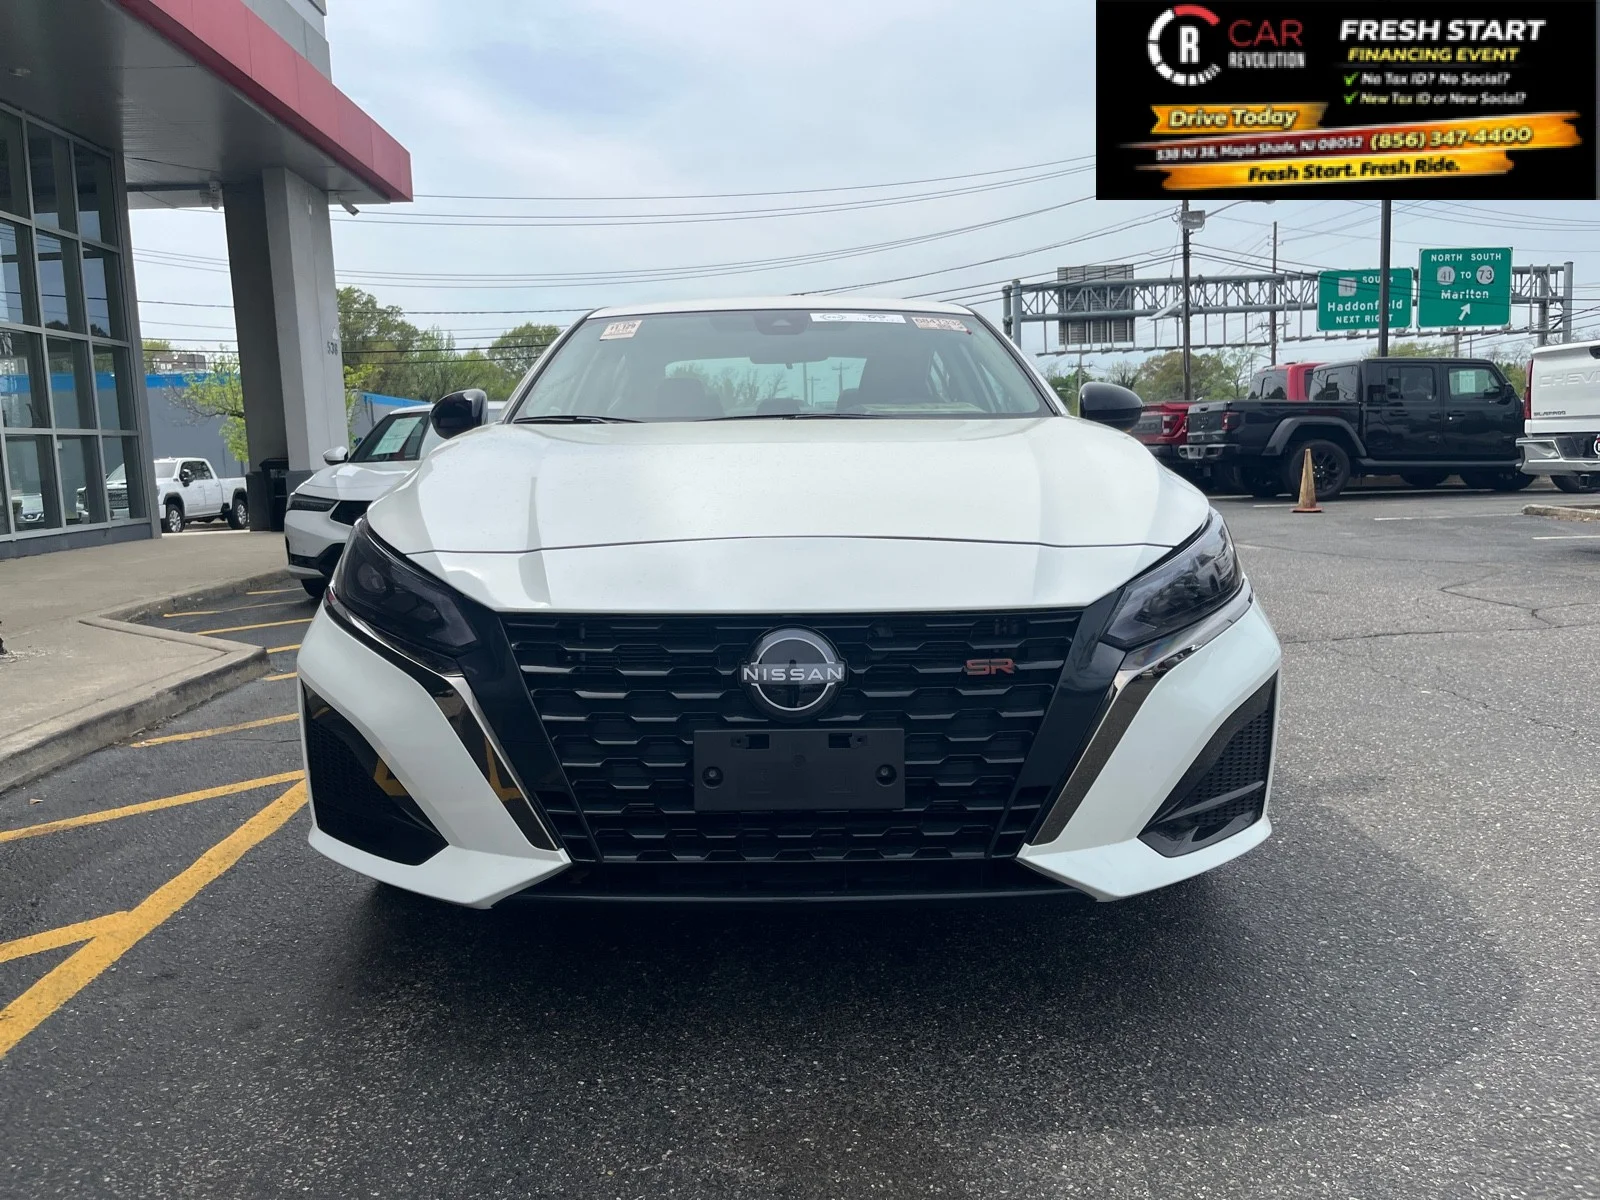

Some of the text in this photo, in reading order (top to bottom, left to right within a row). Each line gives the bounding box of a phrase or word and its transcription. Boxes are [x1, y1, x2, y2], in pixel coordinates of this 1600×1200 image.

[1431, 252, 1501, 262] NORTH SOUTH
[1440, 269, 1493, 280] 41 TO 73
[1441, 289, 1489, 300] Marlton
[1327, 300, 1403, 312] Haddonfld
[1336, 314, 1393, 324] NEXT RIGT
[966, 658, 1015, 676] SR
[743, 667, 843, 681] NISSAN
